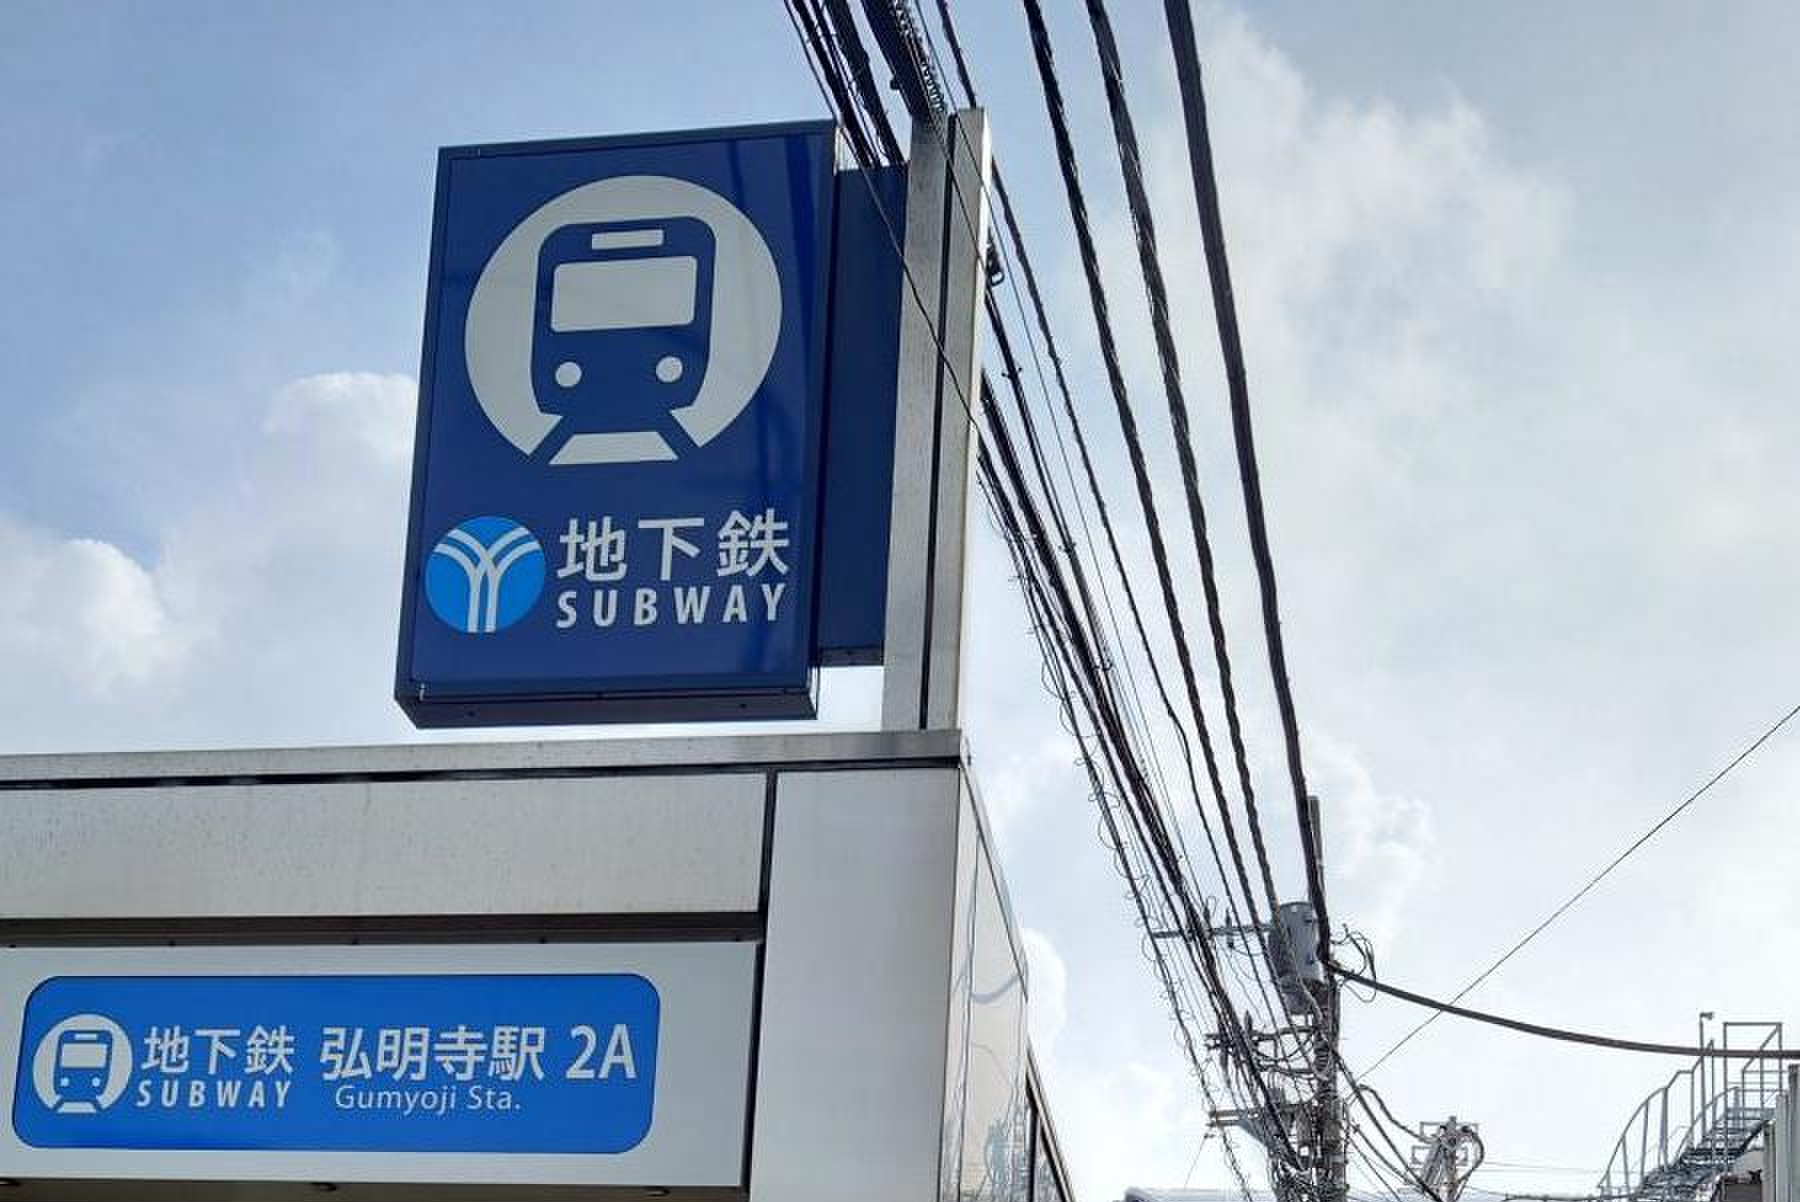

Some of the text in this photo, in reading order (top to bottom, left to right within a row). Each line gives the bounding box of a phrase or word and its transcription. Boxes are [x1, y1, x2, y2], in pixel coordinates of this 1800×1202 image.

[556, 508, 790, 582] 地下鉄
[556, 583, 786, 628] SUBWAY
[140, 1023, 637, 1081] 地下鉄 弘明寺駅 2A
[137, 1080, 291, 1108] SUBWAY
[334, 1085, 522, 1116] Gumyoji Sta.
